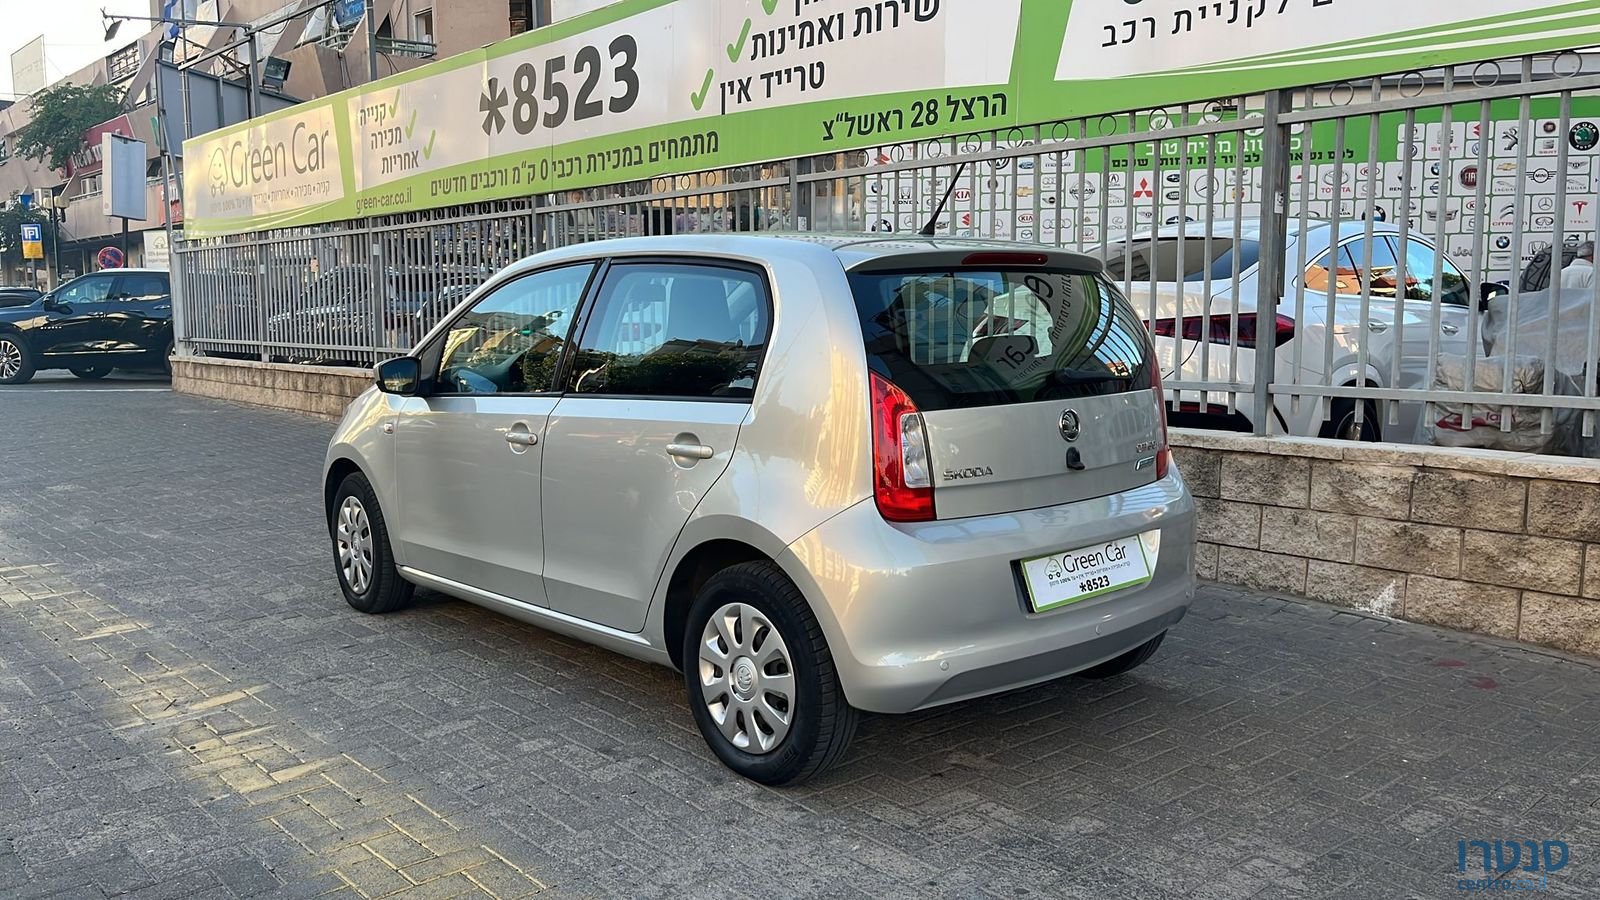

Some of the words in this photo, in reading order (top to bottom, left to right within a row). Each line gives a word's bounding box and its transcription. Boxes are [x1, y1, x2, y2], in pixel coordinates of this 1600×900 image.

[852, 0, 940, 37] שירות
[1101, 16, 1156, 48] רכב
[750, 16, 844, 62] ואמינות
[760, 60, 825, 98] טרייד
[719, 76, 752, 116] אין
[946, 92, 1007, 122] הרצל
[359, 102, 387, 126] קנייה
[911, 98, 939, 128] 28
[370, 127, 402, 150] מכירה
[649, 130, 719, 163] מתמחים
[230, 140, 287, 188] Green
[292, 122, 329, 174] Car
[381, 150, 419, 175] אחריות
[551, 155, 582, 178] רכבי
[588, 145, 643, 173] במכירת
[1328, 149, 1354, 159] לם
[470, 167, 508, 193] ורכבים
[539, 158, 549, 181] 0
[430, 173, 467, 197] חדשים
[356, 186, 412, 215] green-car.co.il
[1063, 551, 1105, 573] Green
[1105, 544, 1126, 563] Car
